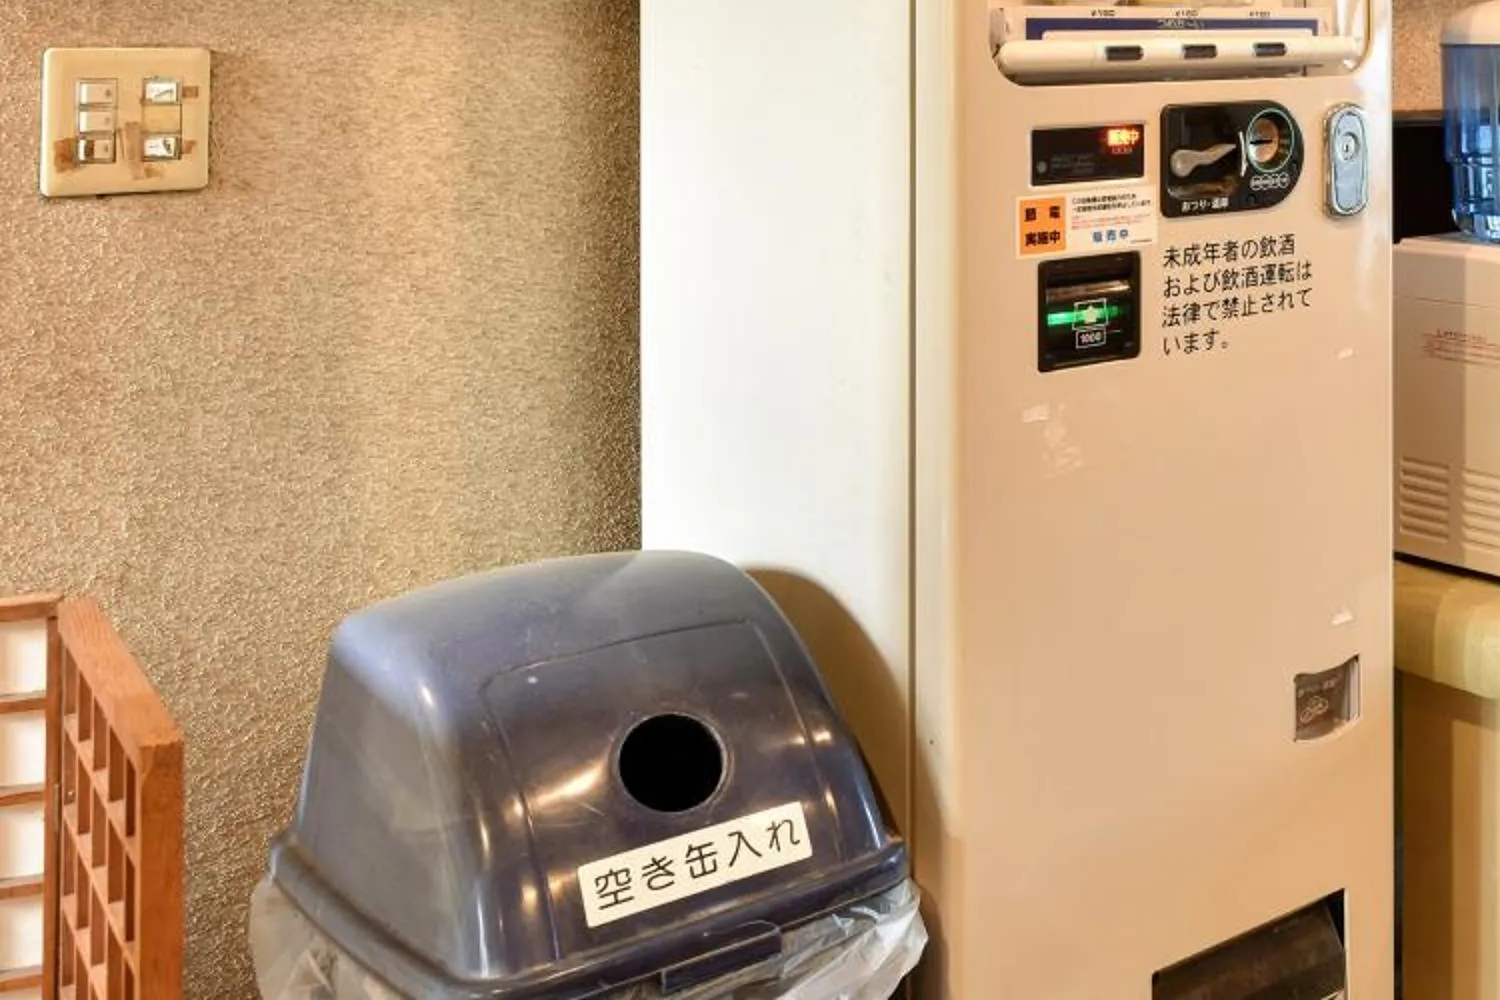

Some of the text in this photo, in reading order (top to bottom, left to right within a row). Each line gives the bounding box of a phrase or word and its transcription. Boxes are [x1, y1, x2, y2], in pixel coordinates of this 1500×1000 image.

[1163, 233, 1295, 268] 未成年者の飲酒
[1163, 259, 1312, 299] および飲酒運転は
[1161, 287, 1313, 328] 法律で禁止されて
[1163, 328, 1229, 356] います。
[594, 819, 801, 910] 空き缶入れ
